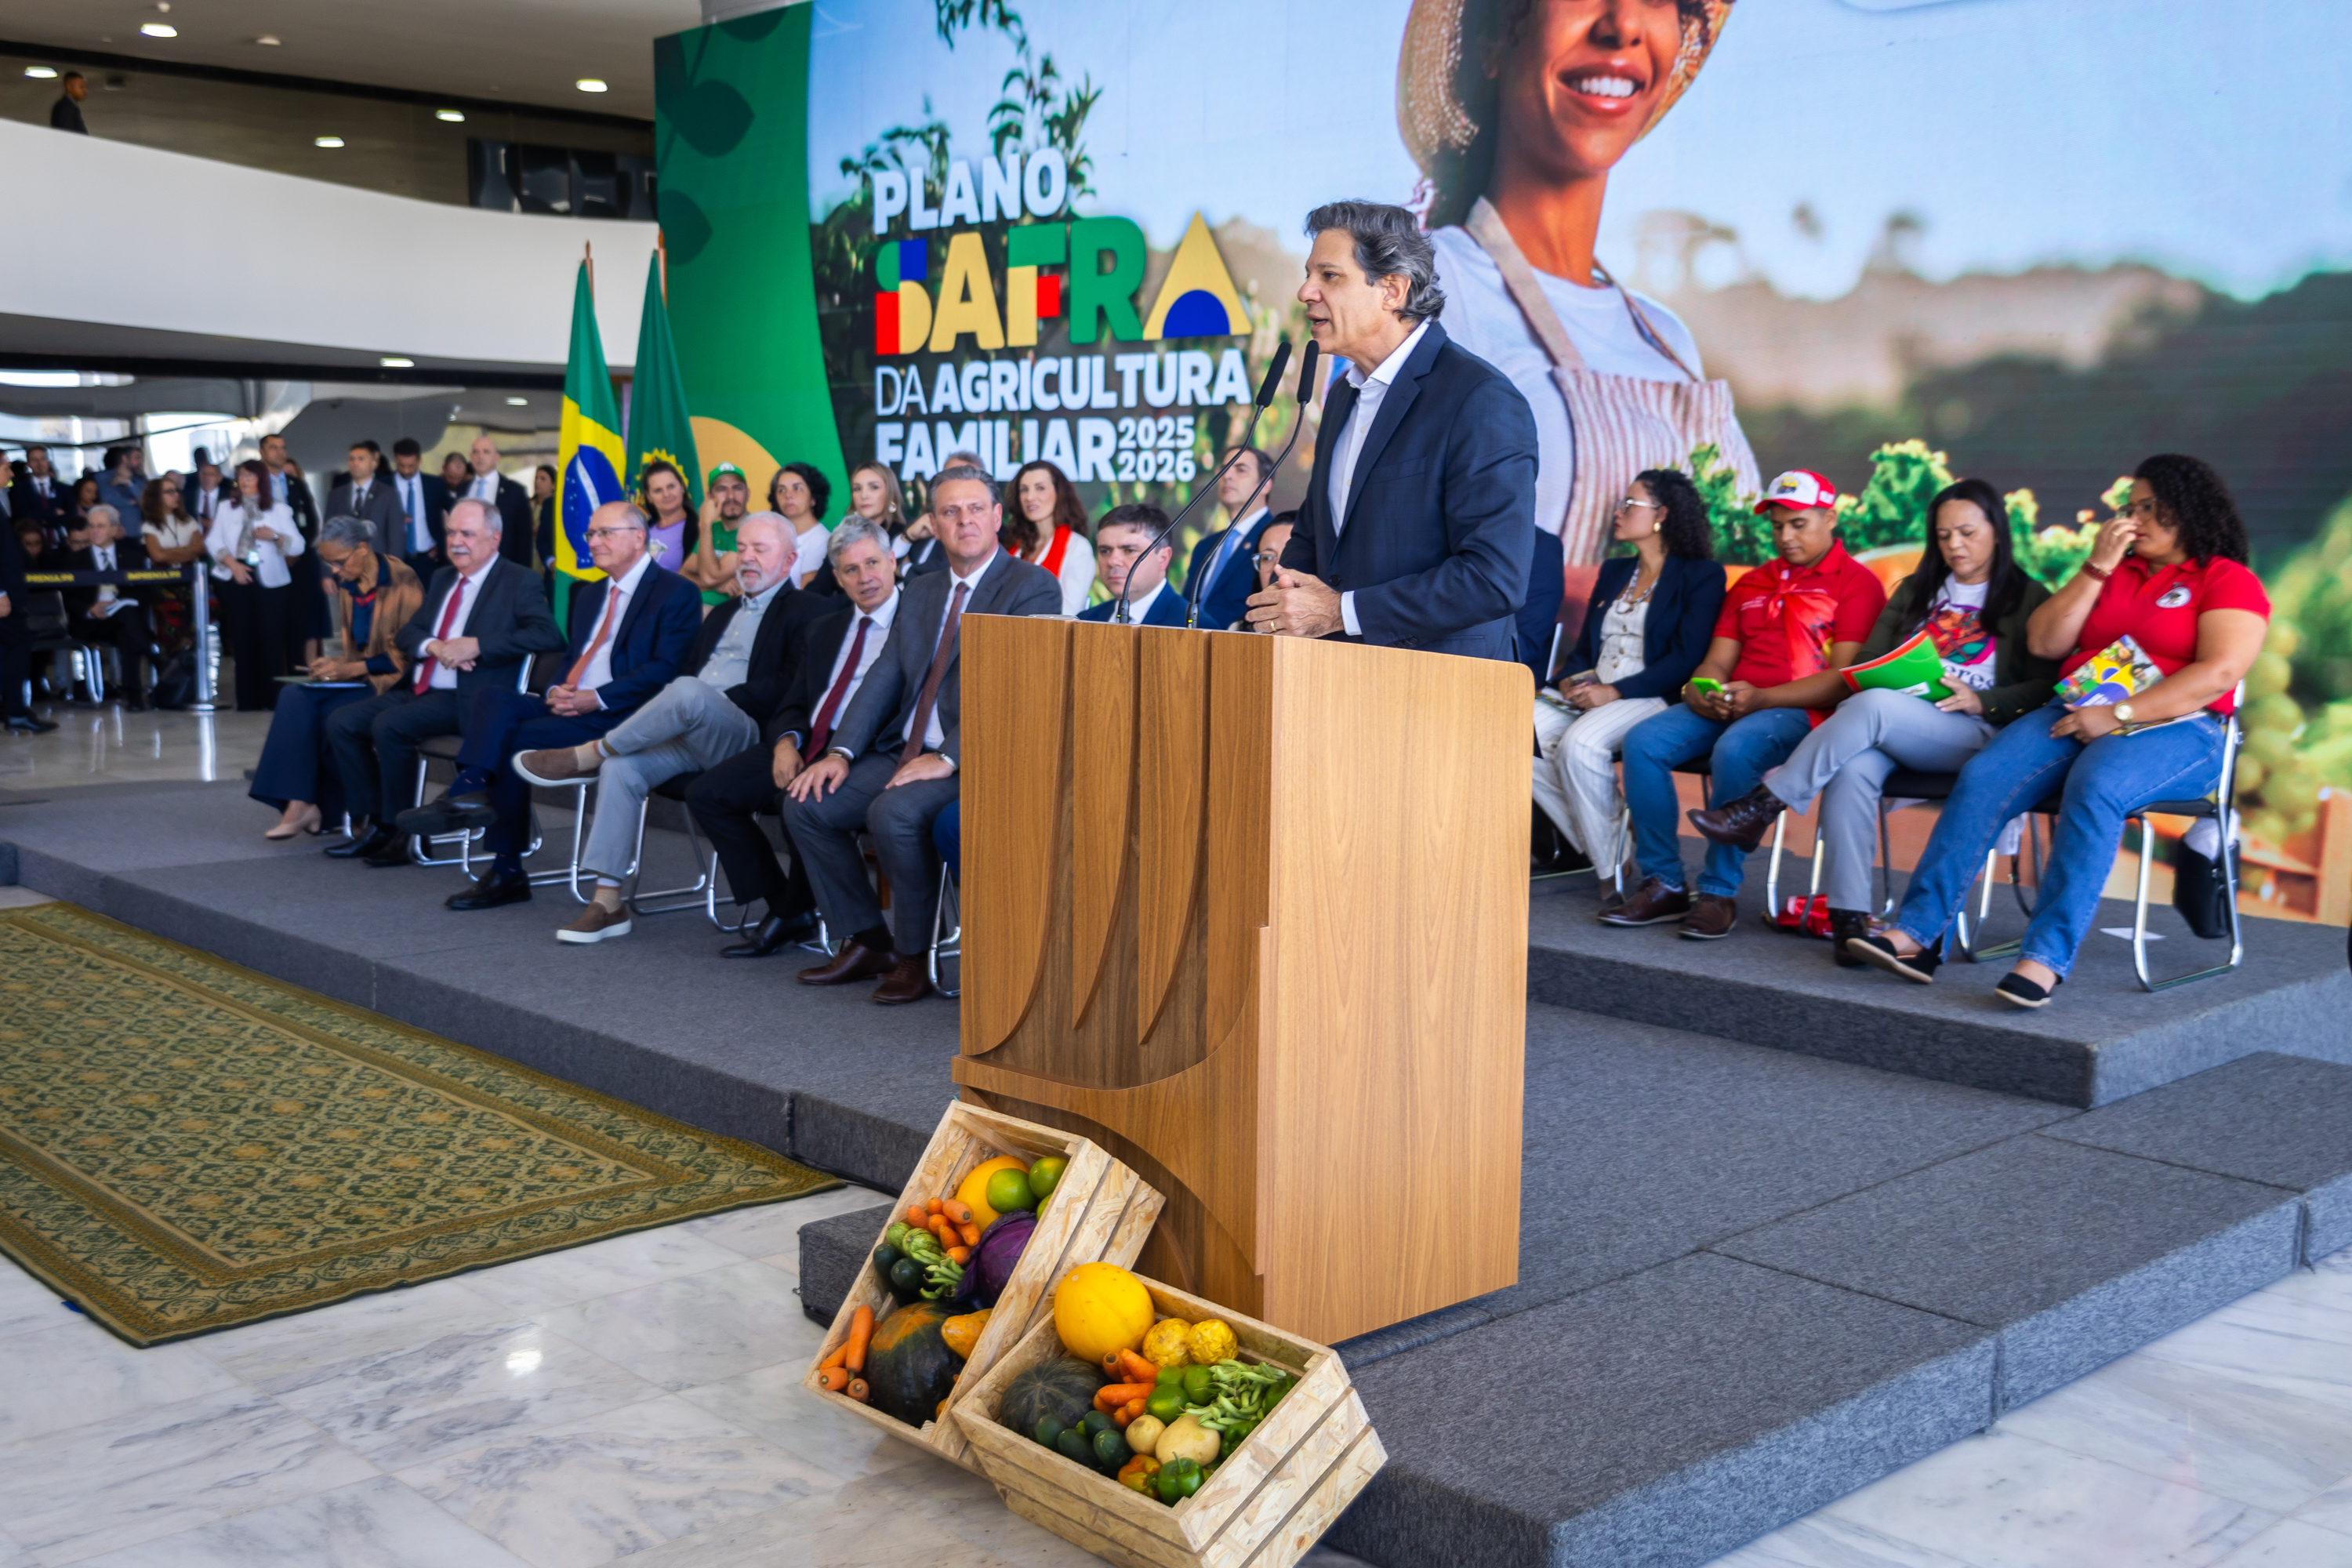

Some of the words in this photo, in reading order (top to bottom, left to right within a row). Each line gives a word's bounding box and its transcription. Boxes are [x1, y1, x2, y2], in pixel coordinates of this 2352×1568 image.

[873, 147, 1068, 235] PLANO
[875, 210, 1253, 356] SAFRA
[875, 364, 928, 416] DA
[931, 348, 1253, 414] AGRICULTURA
[875, 417, 1118, 482] FAMILIAR
[1117, 416, 1196, 449] 2025
[1117, 449, 1196, 482] 2026
